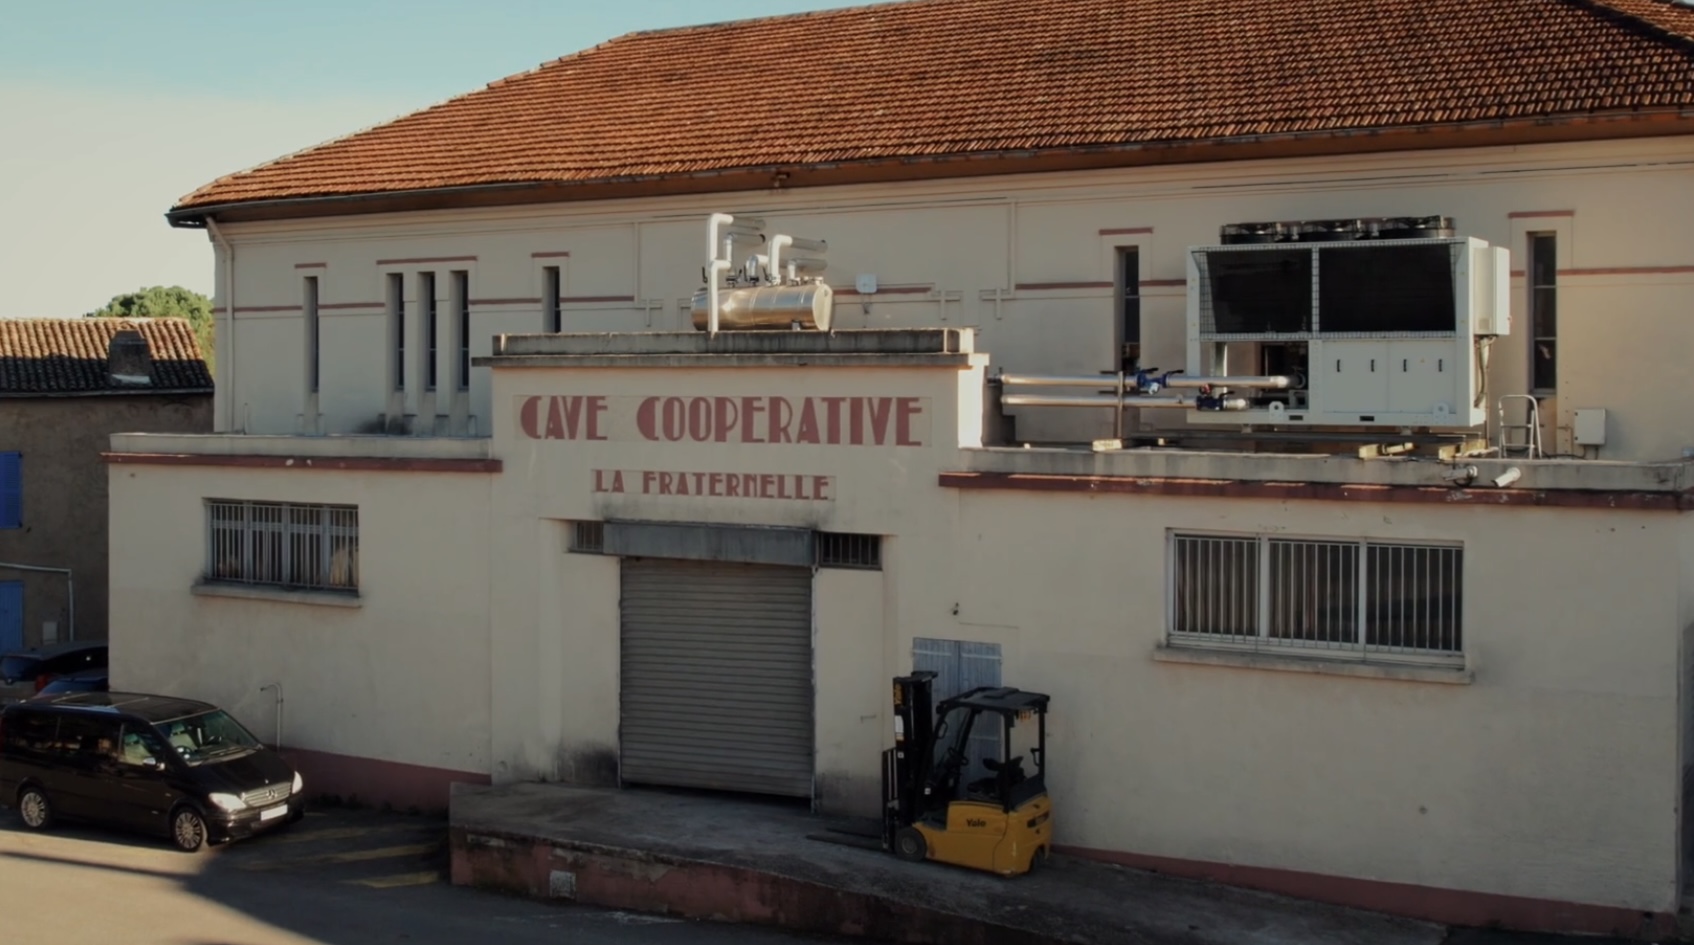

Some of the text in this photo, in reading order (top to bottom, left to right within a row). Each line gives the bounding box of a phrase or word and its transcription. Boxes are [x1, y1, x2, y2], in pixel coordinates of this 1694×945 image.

[520, 395, 923, 446] CAVE COOPERATIVE
[594, 470, 829, 500] LA FRATERNELLE
